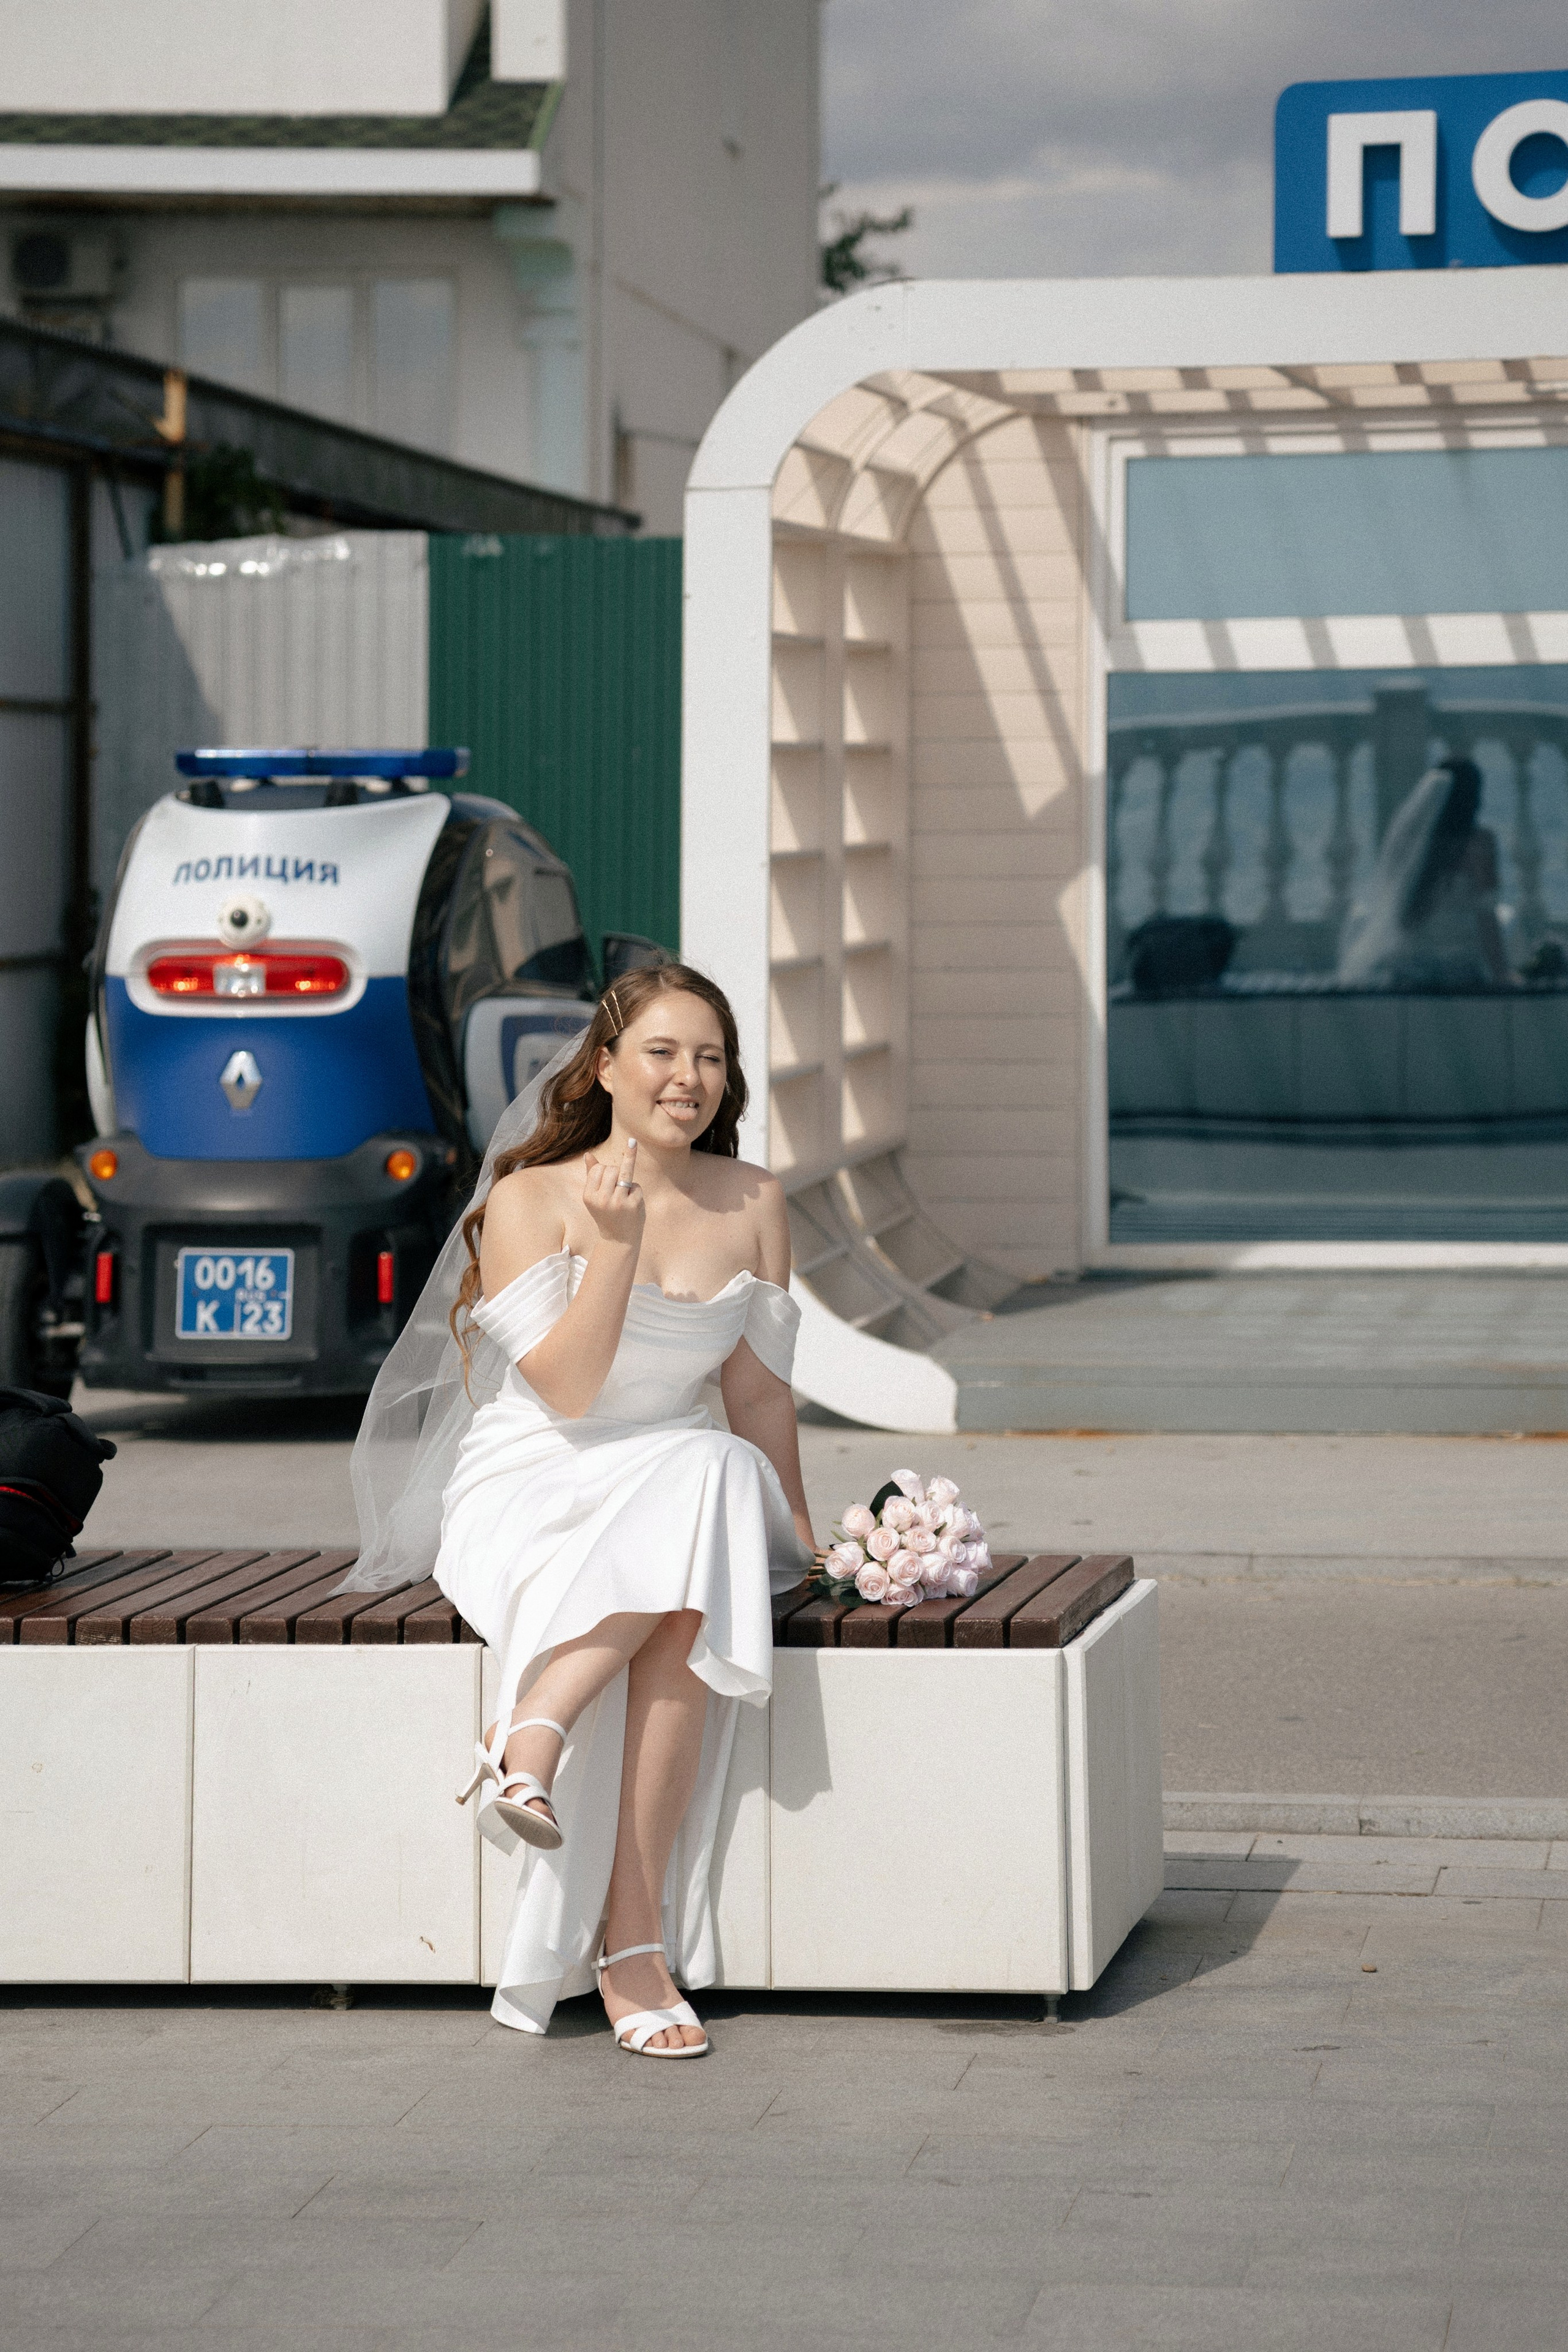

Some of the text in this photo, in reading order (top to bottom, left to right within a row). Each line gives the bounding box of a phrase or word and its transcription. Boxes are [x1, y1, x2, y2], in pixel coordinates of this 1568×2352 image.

[1327, 99, 1568, 238] ПО
[194, 1256, 276, 1291] 0016
[242, 1300, 284, 1333] 23
